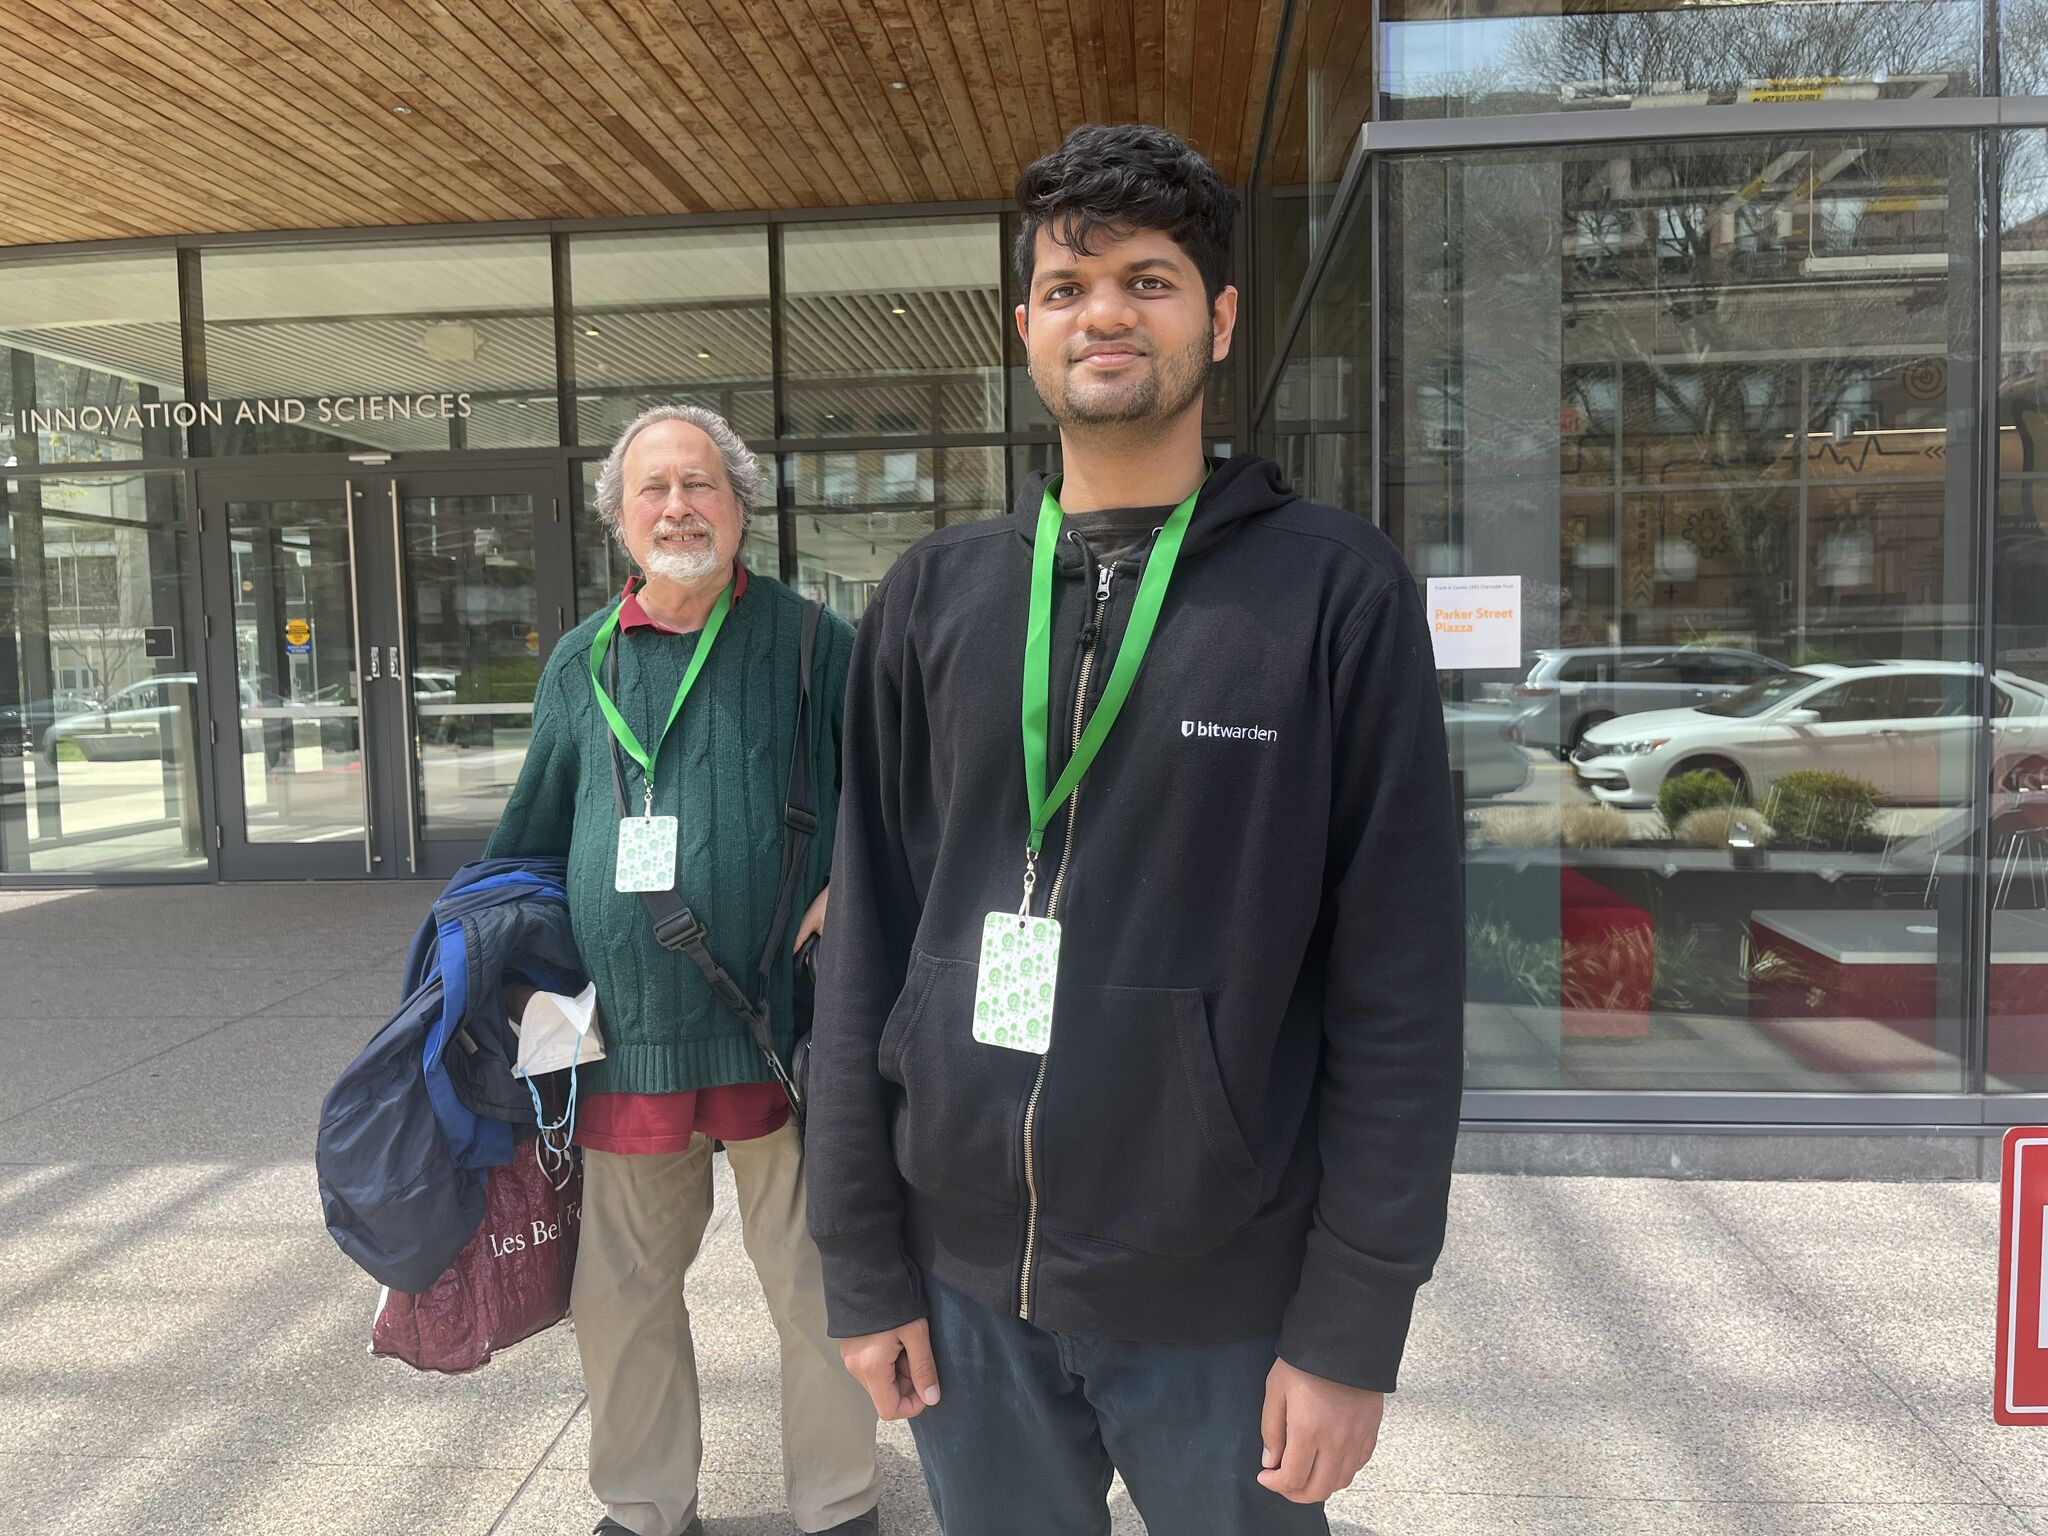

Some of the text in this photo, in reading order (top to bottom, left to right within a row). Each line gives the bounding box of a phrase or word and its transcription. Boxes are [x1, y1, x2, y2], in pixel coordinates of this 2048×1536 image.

[21, 393, 472, 433] INNOVATION AND SCIENCES
[1435, 608, 1513, 620] Parker Street
[1435, 622, 1473, 633] Piazza
[1197, 720, 1278, 742] bitwarden
[489, 1233, 526, 1258] Les
